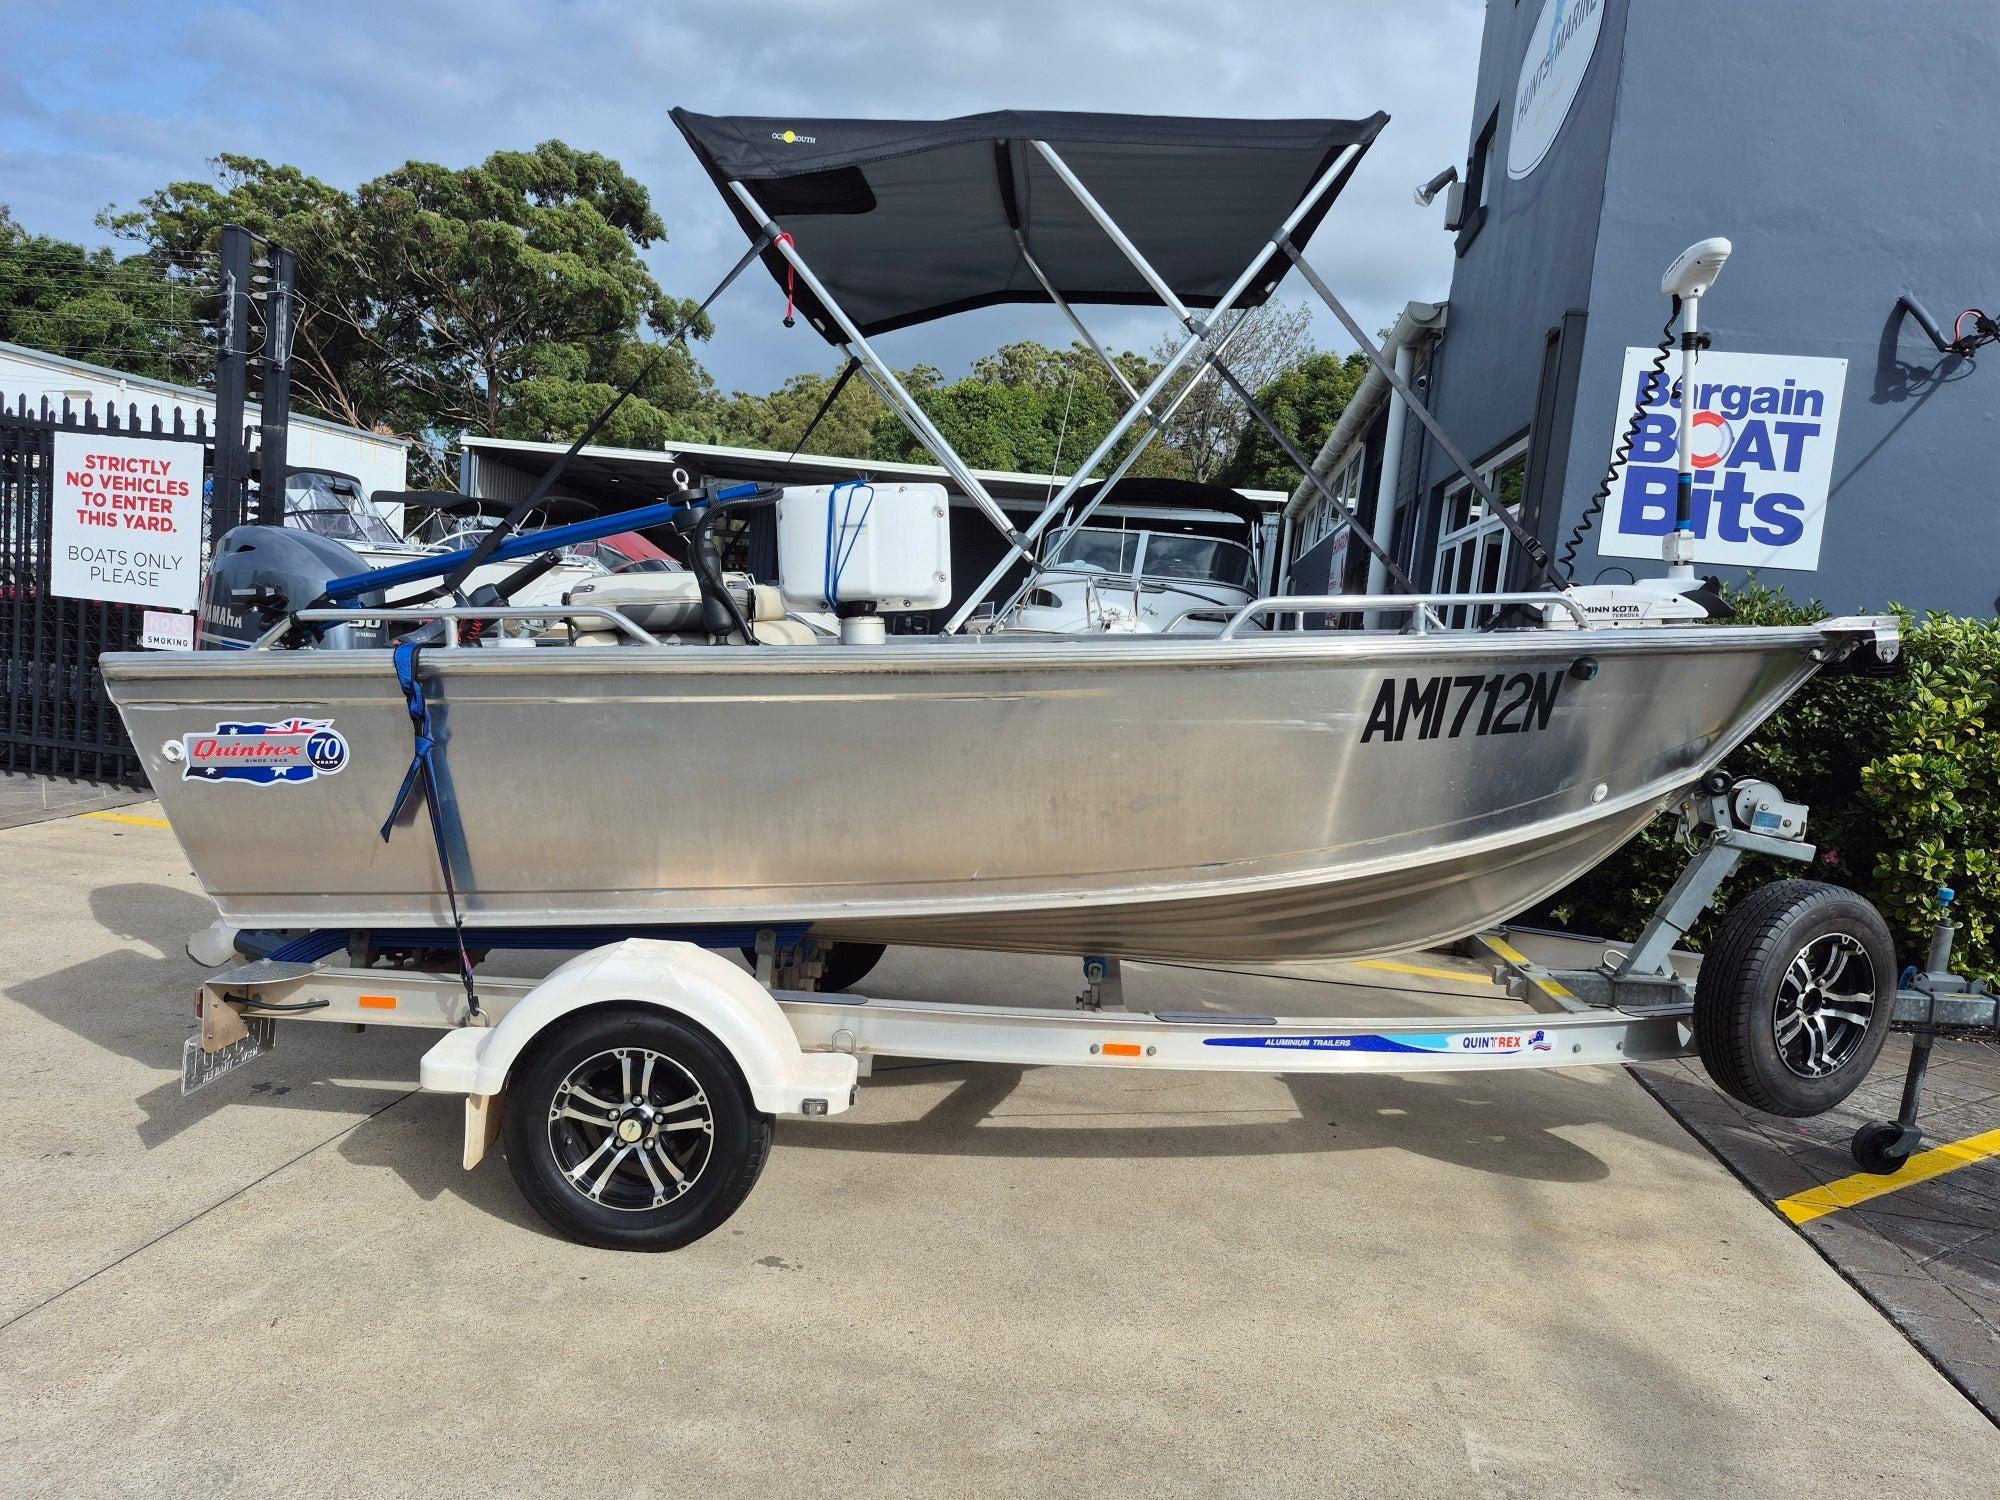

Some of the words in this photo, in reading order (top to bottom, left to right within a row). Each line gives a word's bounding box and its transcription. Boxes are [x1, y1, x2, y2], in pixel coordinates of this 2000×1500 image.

[1627, 411, 1821, 473] BOAT
[85, 454, 171, 476] STRICTLY
[66, 471, 94, 488] NO
[99, 474, 190, 497] VEHICLES
[82, 491, 107, 507] TO
[112, 494, 173, 514] ENTER
[1618, 465, 1806, 547] Bits
[77, 509, 118, 527] THIS
[123, 513, 177, 533] YARD.
[68, 545, 127, 566] BOATS
[134, 552, 183, 570] ONLY
[90, 566, 159, 587] PLEASE
[1612, 605, 1640, 613] KOTA
[150, 616, 169, 632] NO
[147, 635, 188, 647] SMOKING
[193, 739, 303, 760] Quintrex
[310, 737, 341, 760] 70
[1265, 1038, 1310, 1046] ALUMINIUM
[1313, 1039, 1351, 1047] TRAILERS
[1462, 1036, 1521, 1049] QUINTREX
